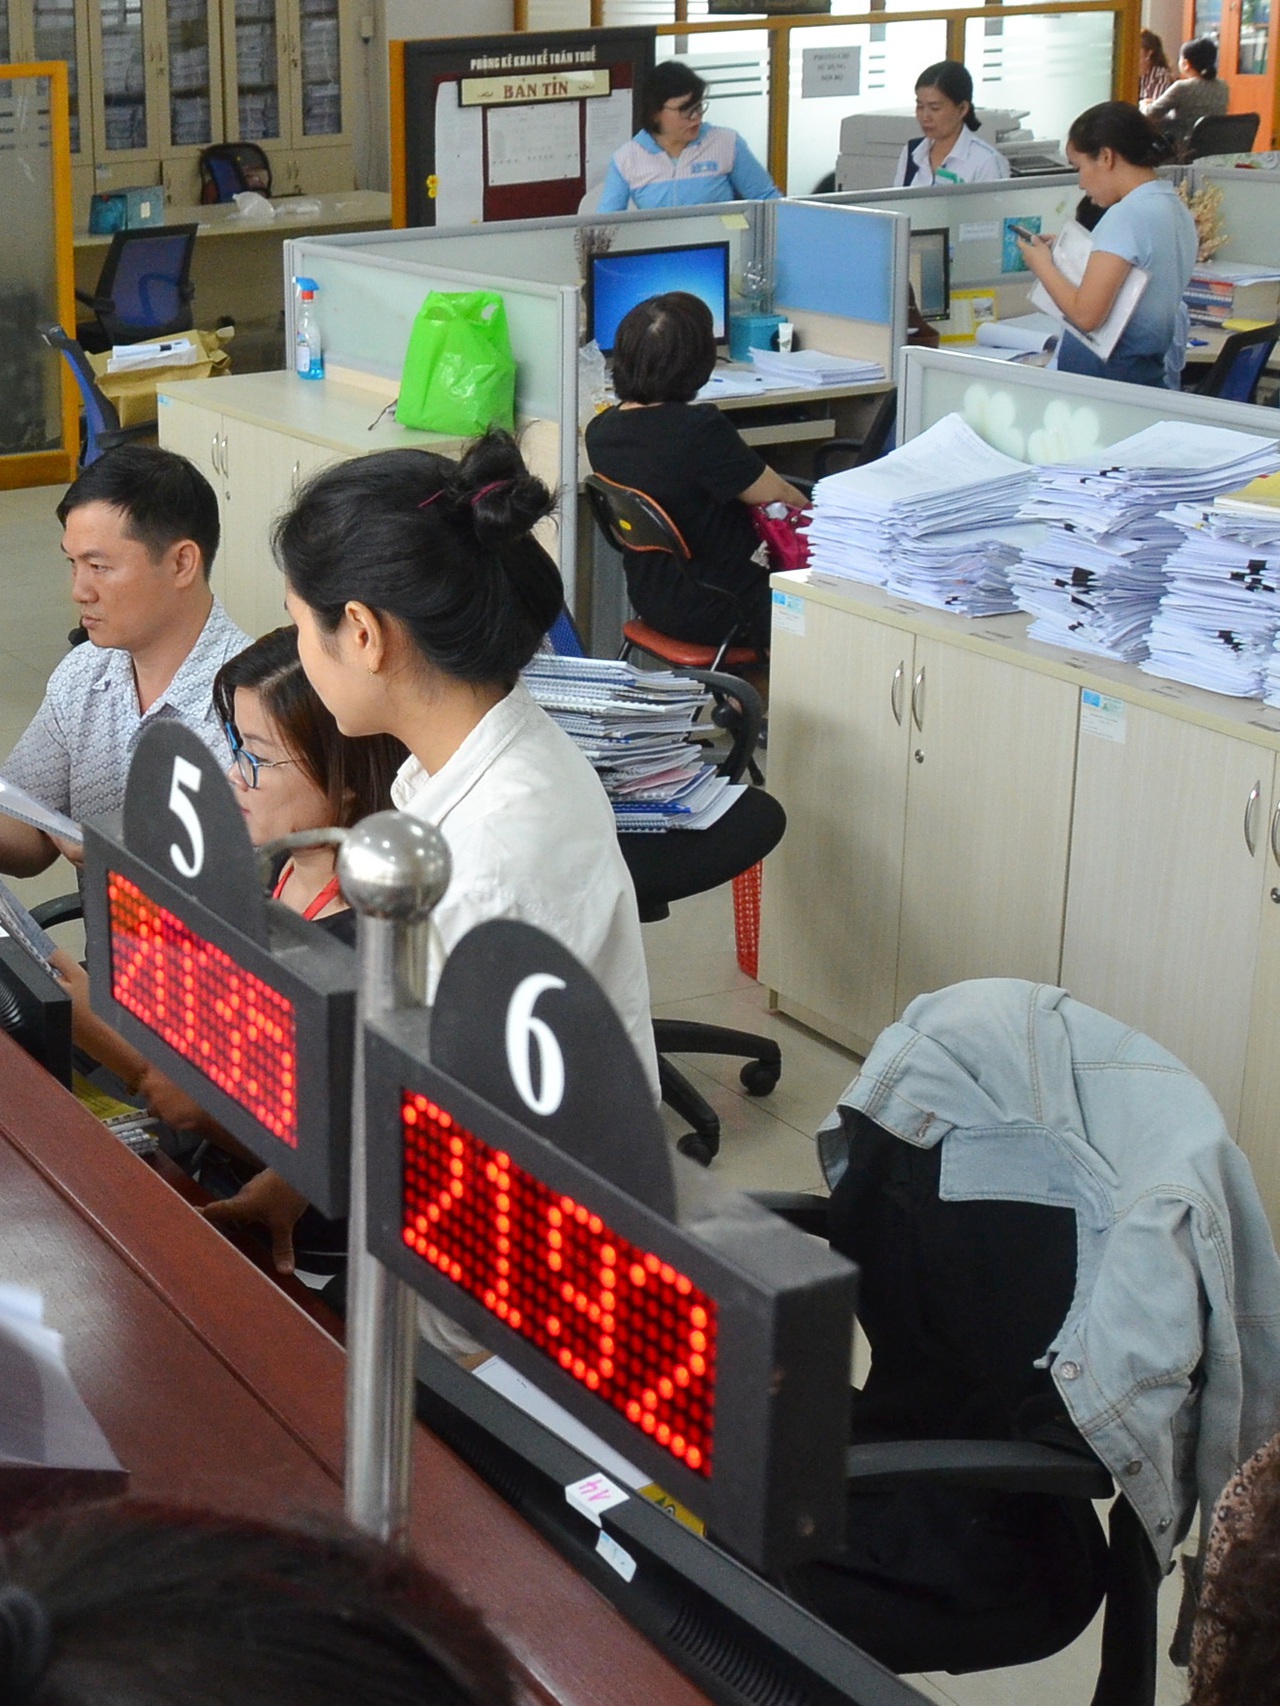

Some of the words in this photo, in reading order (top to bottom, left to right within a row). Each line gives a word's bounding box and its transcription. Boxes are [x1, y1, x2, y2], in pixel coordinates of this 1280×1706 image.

[513, 55, 536, 67] KHAI
[549, 50, 574, 65] TOÁN
[169, 755, 205, 878] 5
[506, 973, 567, 1117] 6
[403, 1094, 708, 1470] 2192
